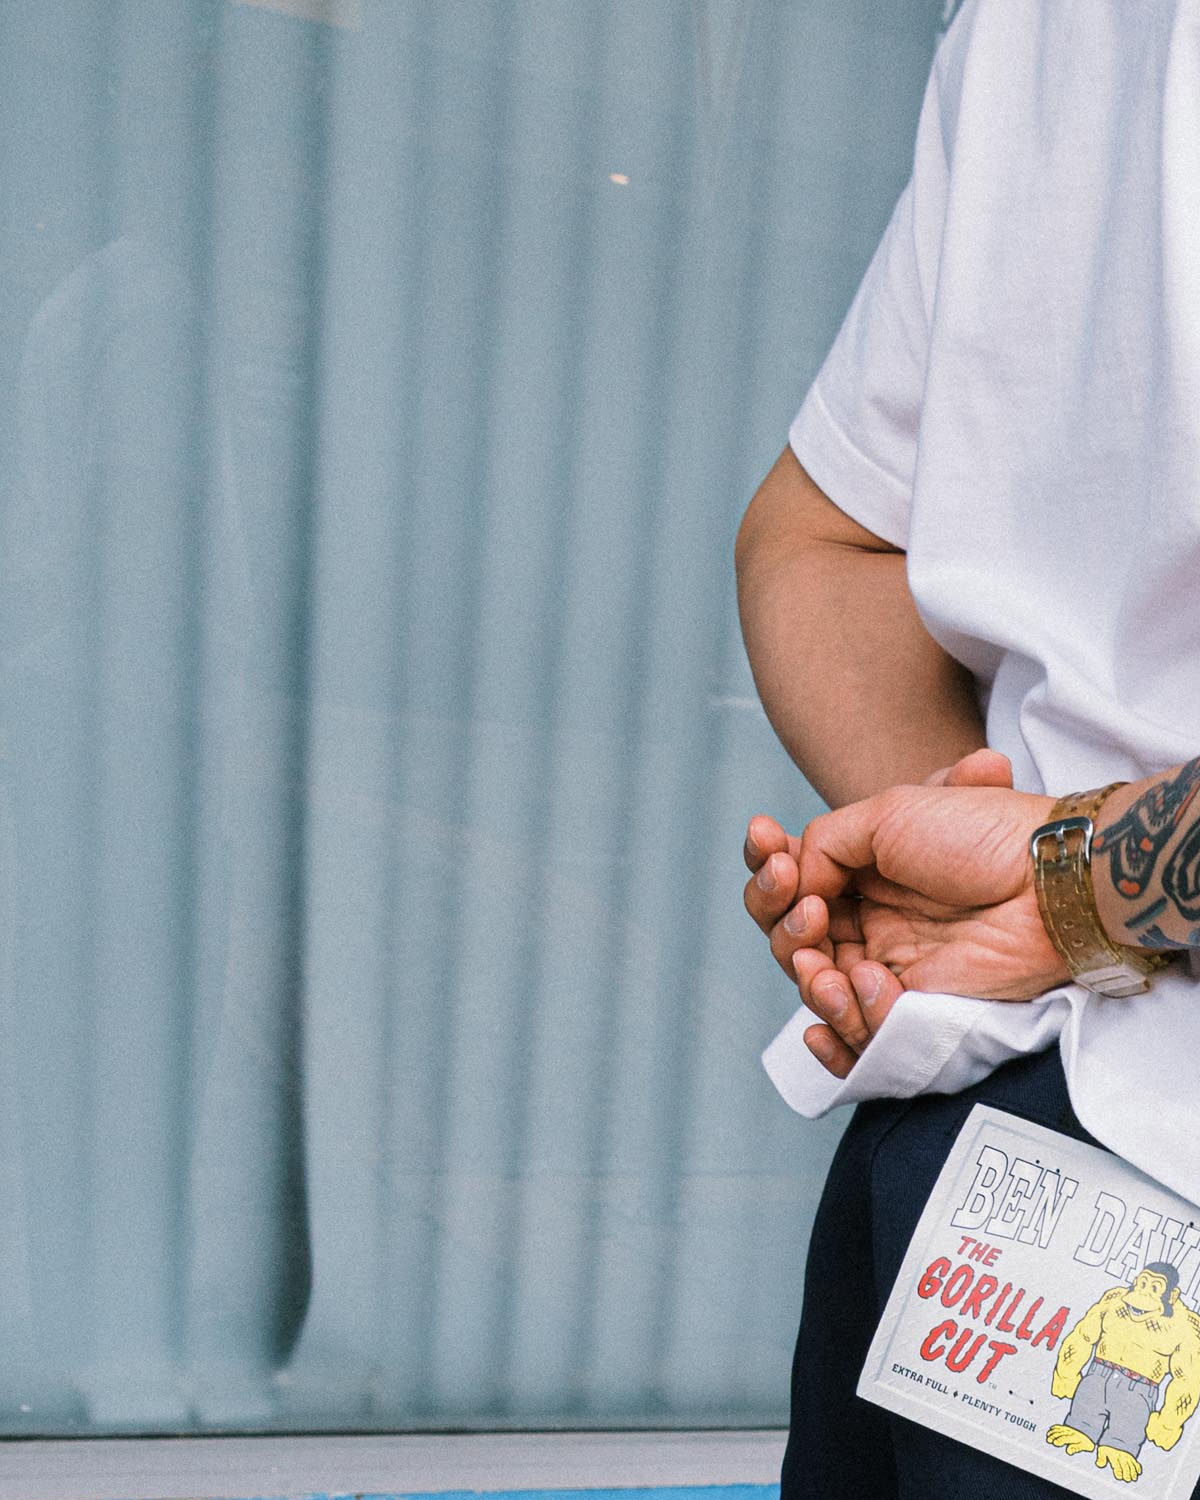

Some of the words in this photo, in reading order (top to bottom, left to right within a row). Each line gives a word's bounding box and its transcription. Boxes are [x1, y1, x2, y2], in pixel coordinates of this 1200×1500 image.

[951, 1145, 1079, 1250] BEN
[956, 1236, 1003, 1268] THE
[916, 1256, 1070, 1352] GORILLA
[919, 1320, 1018, 1384] CUT
[892, 1363, 924, 1384] EXTRA
[925, 1377, 949, 1395] FULL
[961, 1393, 1002, 1417] PLENTY
[1004, 1411, 1038, 1432] TOUGH
